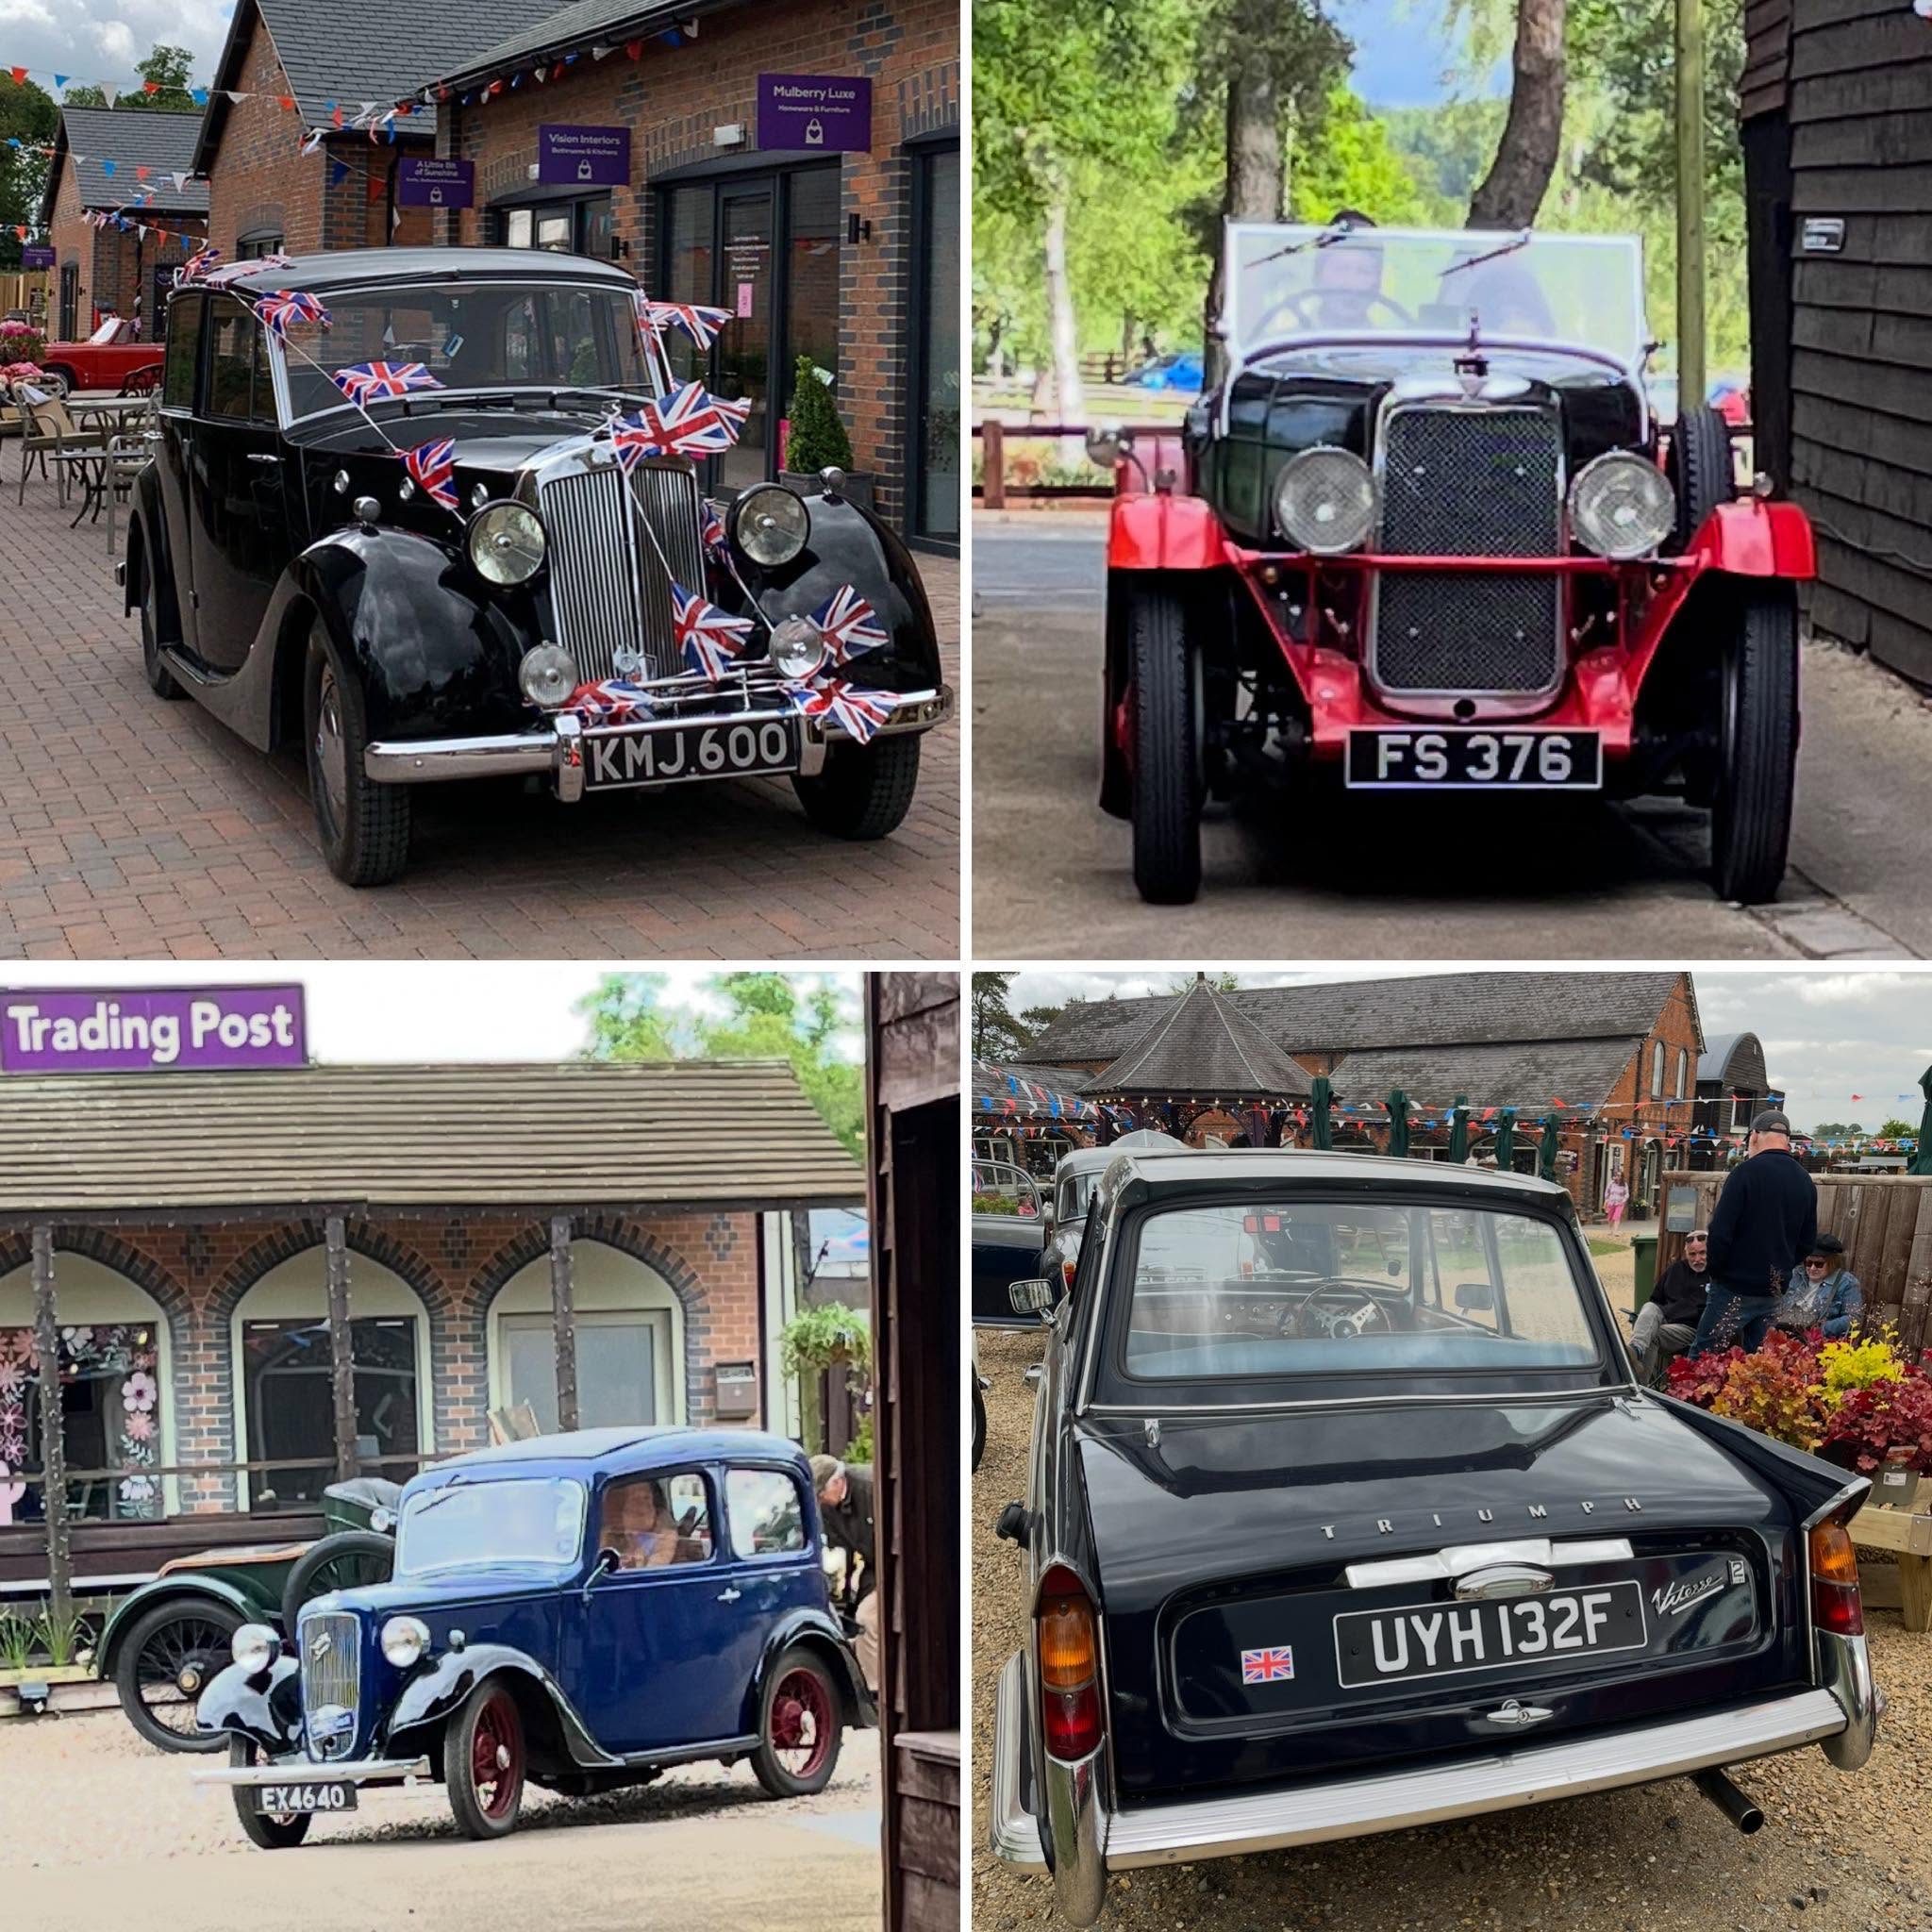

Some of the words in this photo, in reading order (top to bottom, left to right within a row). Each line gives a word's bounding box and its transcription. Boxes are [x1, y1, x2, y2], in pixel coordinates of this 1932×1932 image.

[774, 86, 826, 101] Mulberry
[828, 88, 856, 99] Luxe
[549, 134, 578, 143] Vision
[580, 135, 620, 144] Interiors
[1377, 734, 1448, 780] FS
[1465, 734, 1572, 781] 376
[7, 1001, 181, 1063] Trading
[191, 1001, 294, 1048] Post
[1321, 1497, 1642, 1540] TRIUMPH
[1651, 1576, 1723, 1615] Vitesse
[1371, 1607, 1486, 1674] UYH
[1498, 1592, 1612, 1657] 132F
[261, 1784, 345, 1811] EX4640
